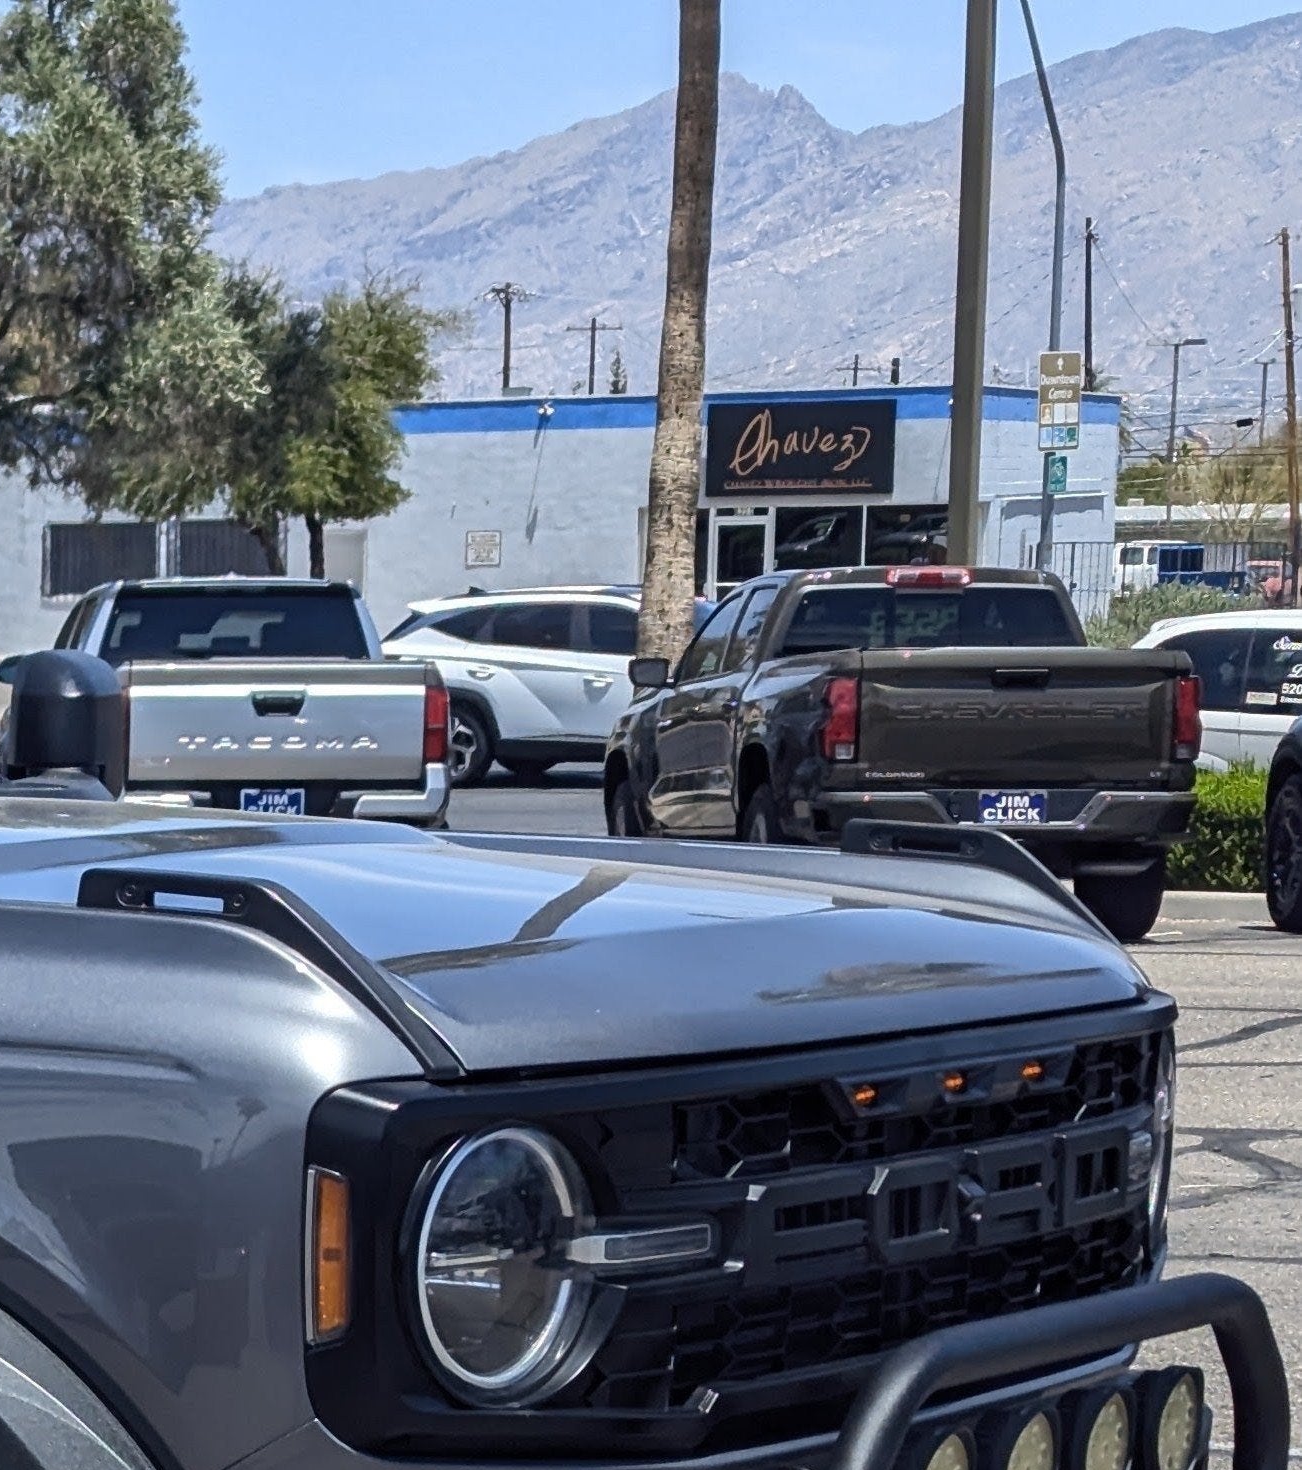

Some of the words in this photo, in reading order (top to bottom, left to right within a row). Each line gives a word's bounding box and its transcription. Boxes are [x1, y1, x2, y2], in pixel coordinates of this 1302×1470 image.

[729, 408, 871, 476] Chavez
[896, 702, 1149, 720] CHEVROLET
[177, 735, 380, 751] TACOMA
[256, 793, 289, 806] JIM
[995, 795, 1030, 808] JIM
[983, 807, 1041, 822] CLICK
